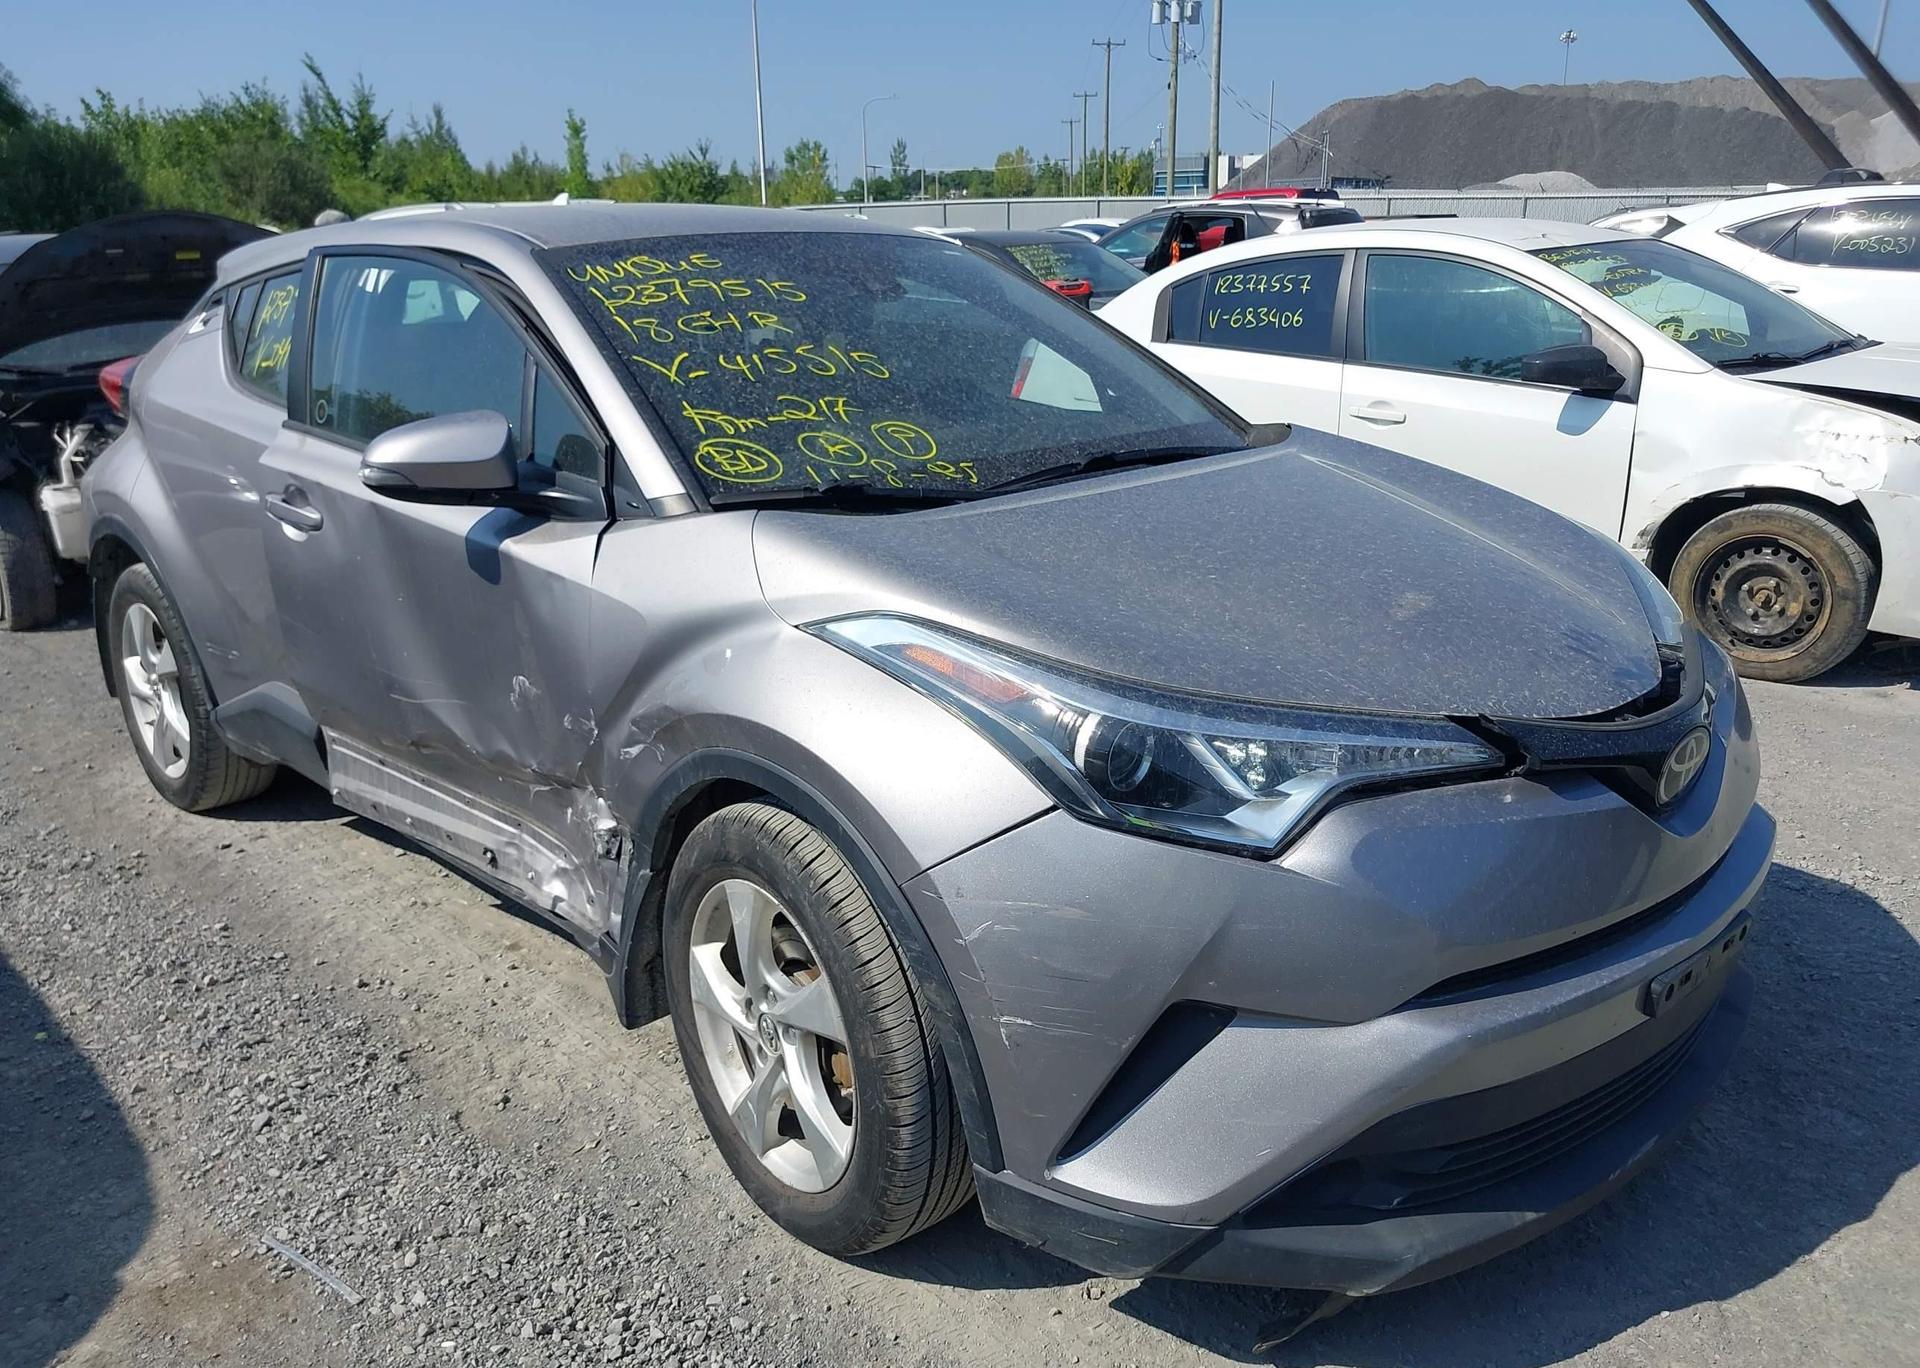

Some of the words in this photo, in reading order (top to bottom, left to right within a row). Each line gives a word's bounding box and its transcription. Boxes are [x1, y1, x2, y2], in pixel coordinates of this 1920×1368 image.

[566, 253, 723, 284] UNIQUE
[589, 278, 807, 314] 12379515
[1215, 274, 1312, 295] 12377557
[255, 285, 299, 338] 1237
[1209, 307, 1304, 329] V-683406
[613, 315, 675, 344] 18
[632, 344, 890, 386] V-415515
